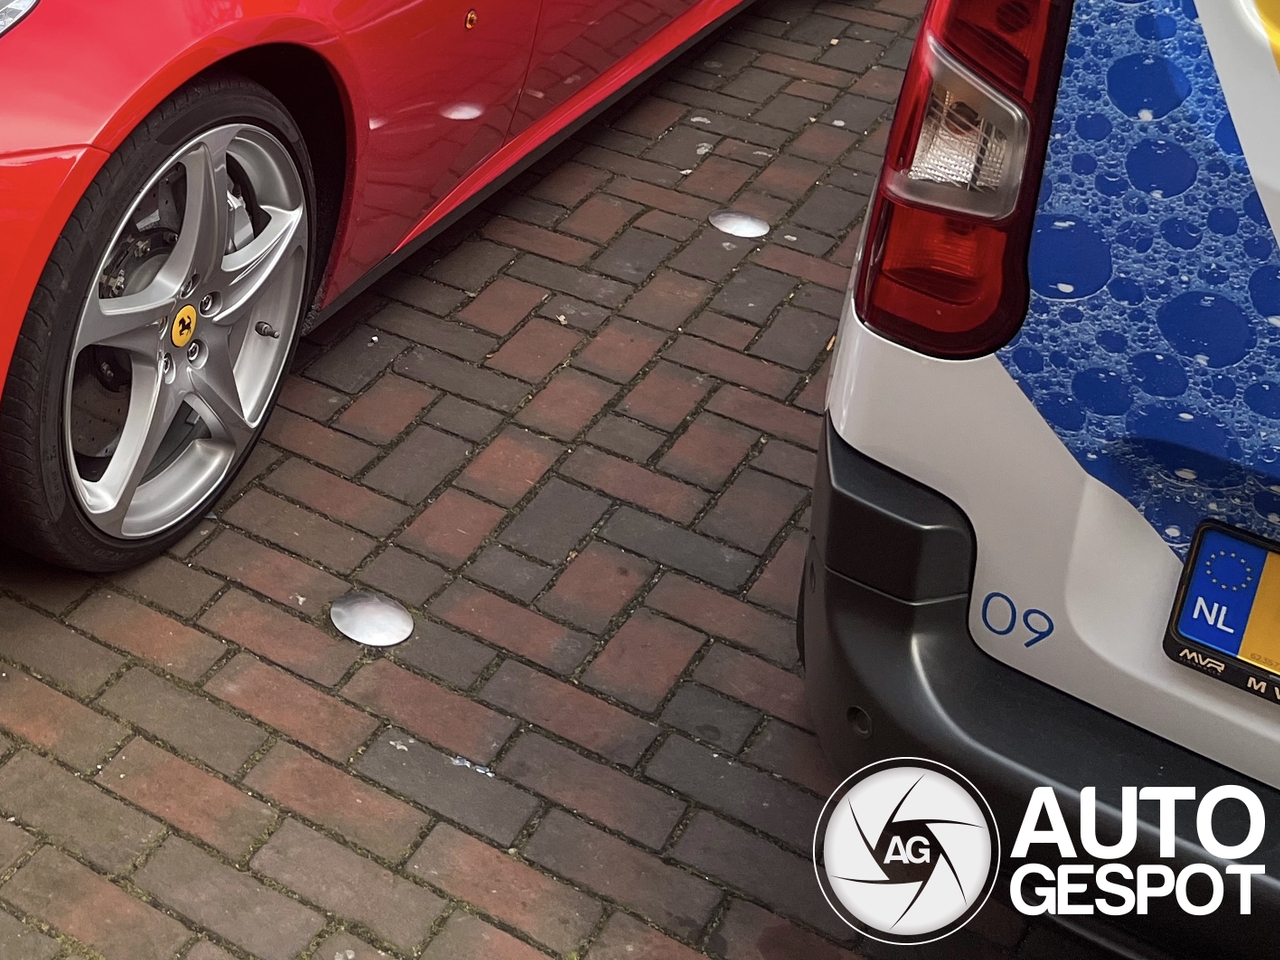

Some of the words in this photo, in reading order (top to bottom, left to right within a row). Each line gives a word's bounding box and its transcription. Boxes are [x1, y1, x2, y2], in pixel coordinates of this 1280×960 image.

[981, 591, 1055, 649] 09
[1192, 595, 1235, 634] NL
[1179, 648, 1226, 674] MVR
